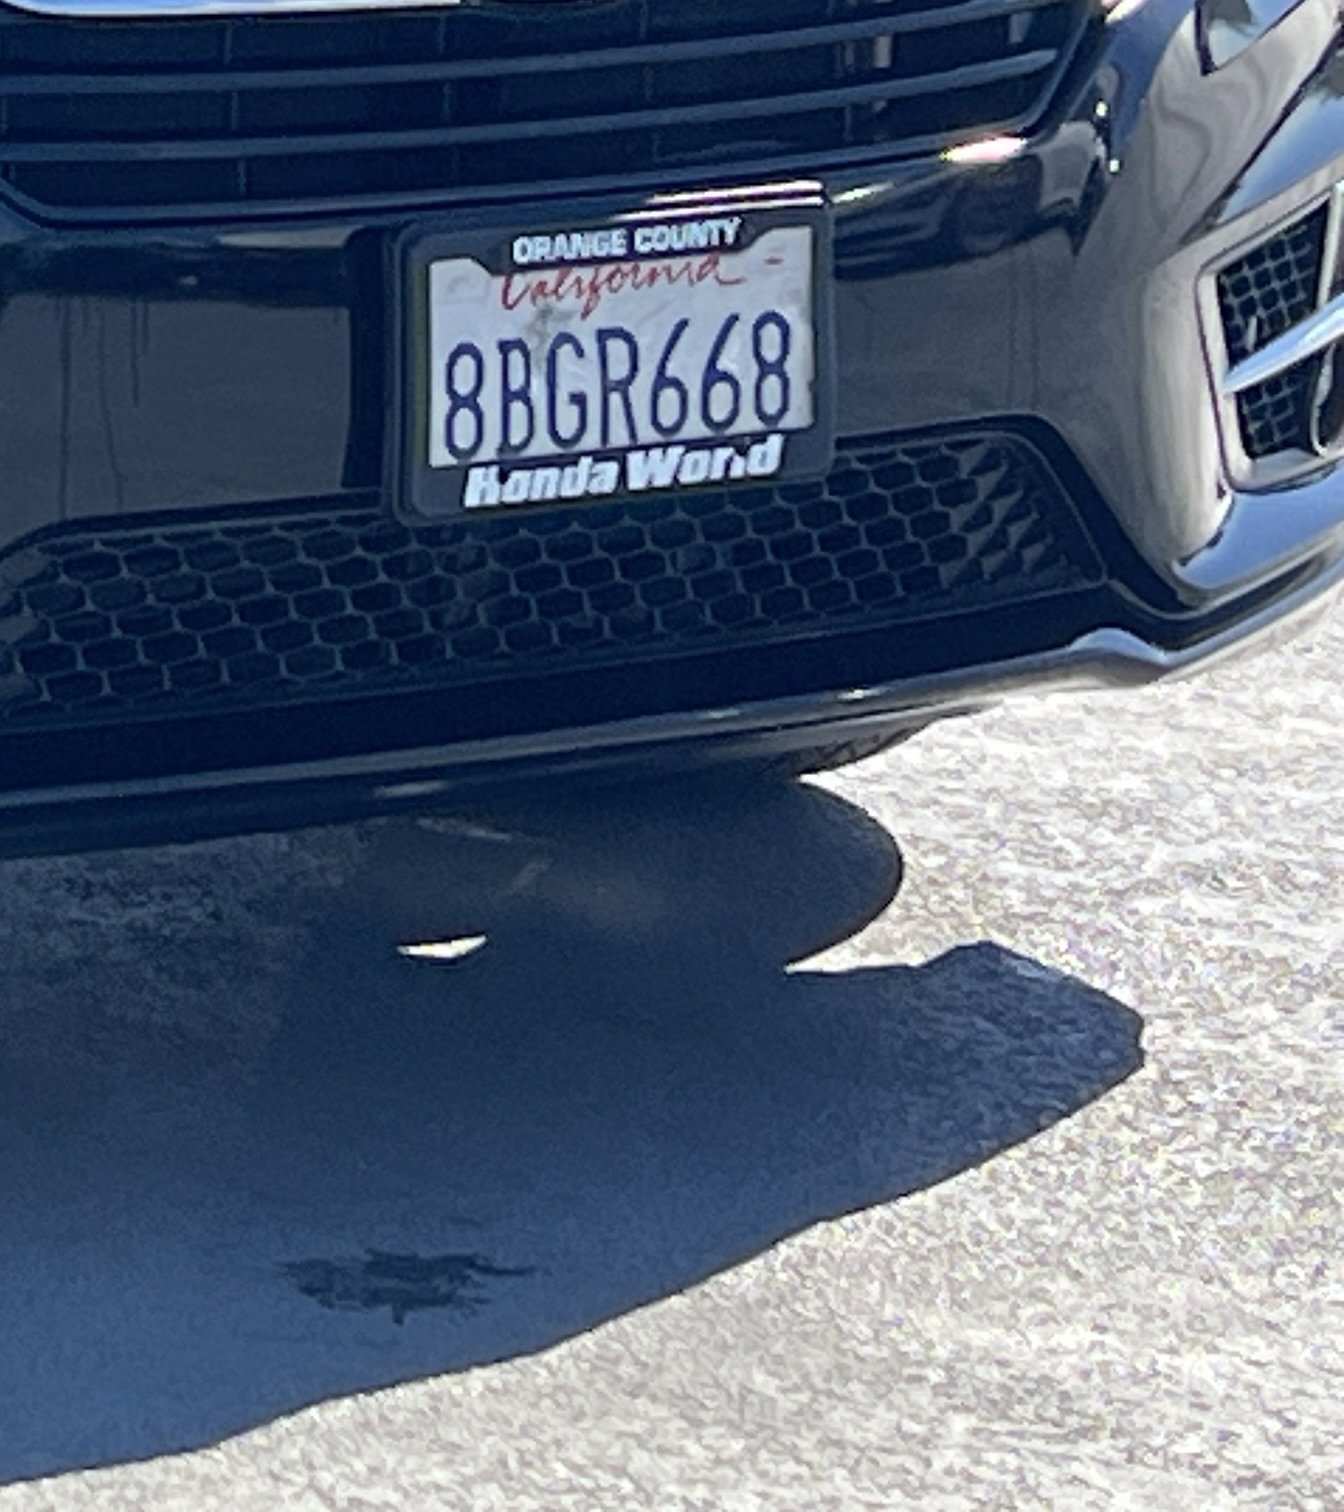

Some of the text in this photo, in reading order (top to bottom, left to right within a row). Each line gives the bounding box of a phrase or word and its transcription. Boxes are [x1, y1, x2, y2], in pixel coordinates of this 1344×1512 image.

[513, 215, 743, 264] ORANGE COUNTY
[500, 250, 748, 321] California
[444, 310, 792, 461] 8BGR668
[464, 454, 620, 508] Honda
